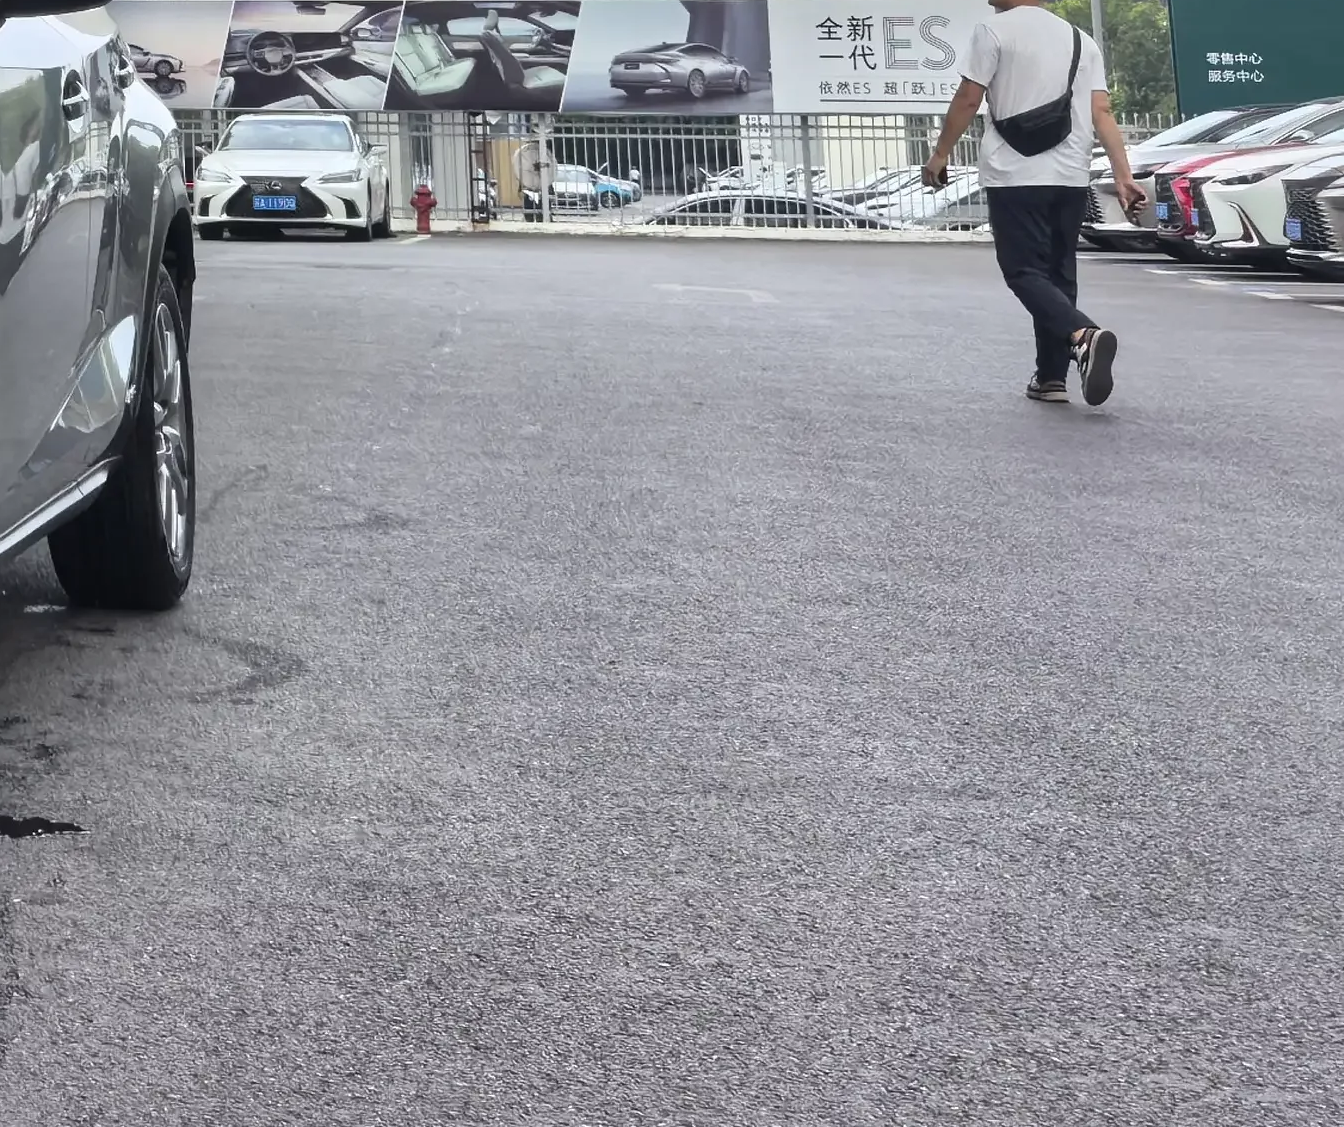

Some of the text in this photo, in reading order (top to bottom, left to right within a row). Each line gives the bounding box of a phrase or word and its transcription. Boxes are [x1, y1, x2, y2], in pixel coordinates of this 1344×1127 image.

[815, 16, 875, 42] 全新
[882, 15, 956, 71] ES
[819, 44, 877, 71] 一代
[1206, 52, 1264, 65] 零售中心
[1208, 69, 1265, 82] 服务中心
[819, 81, 871, 95] 依然ES
